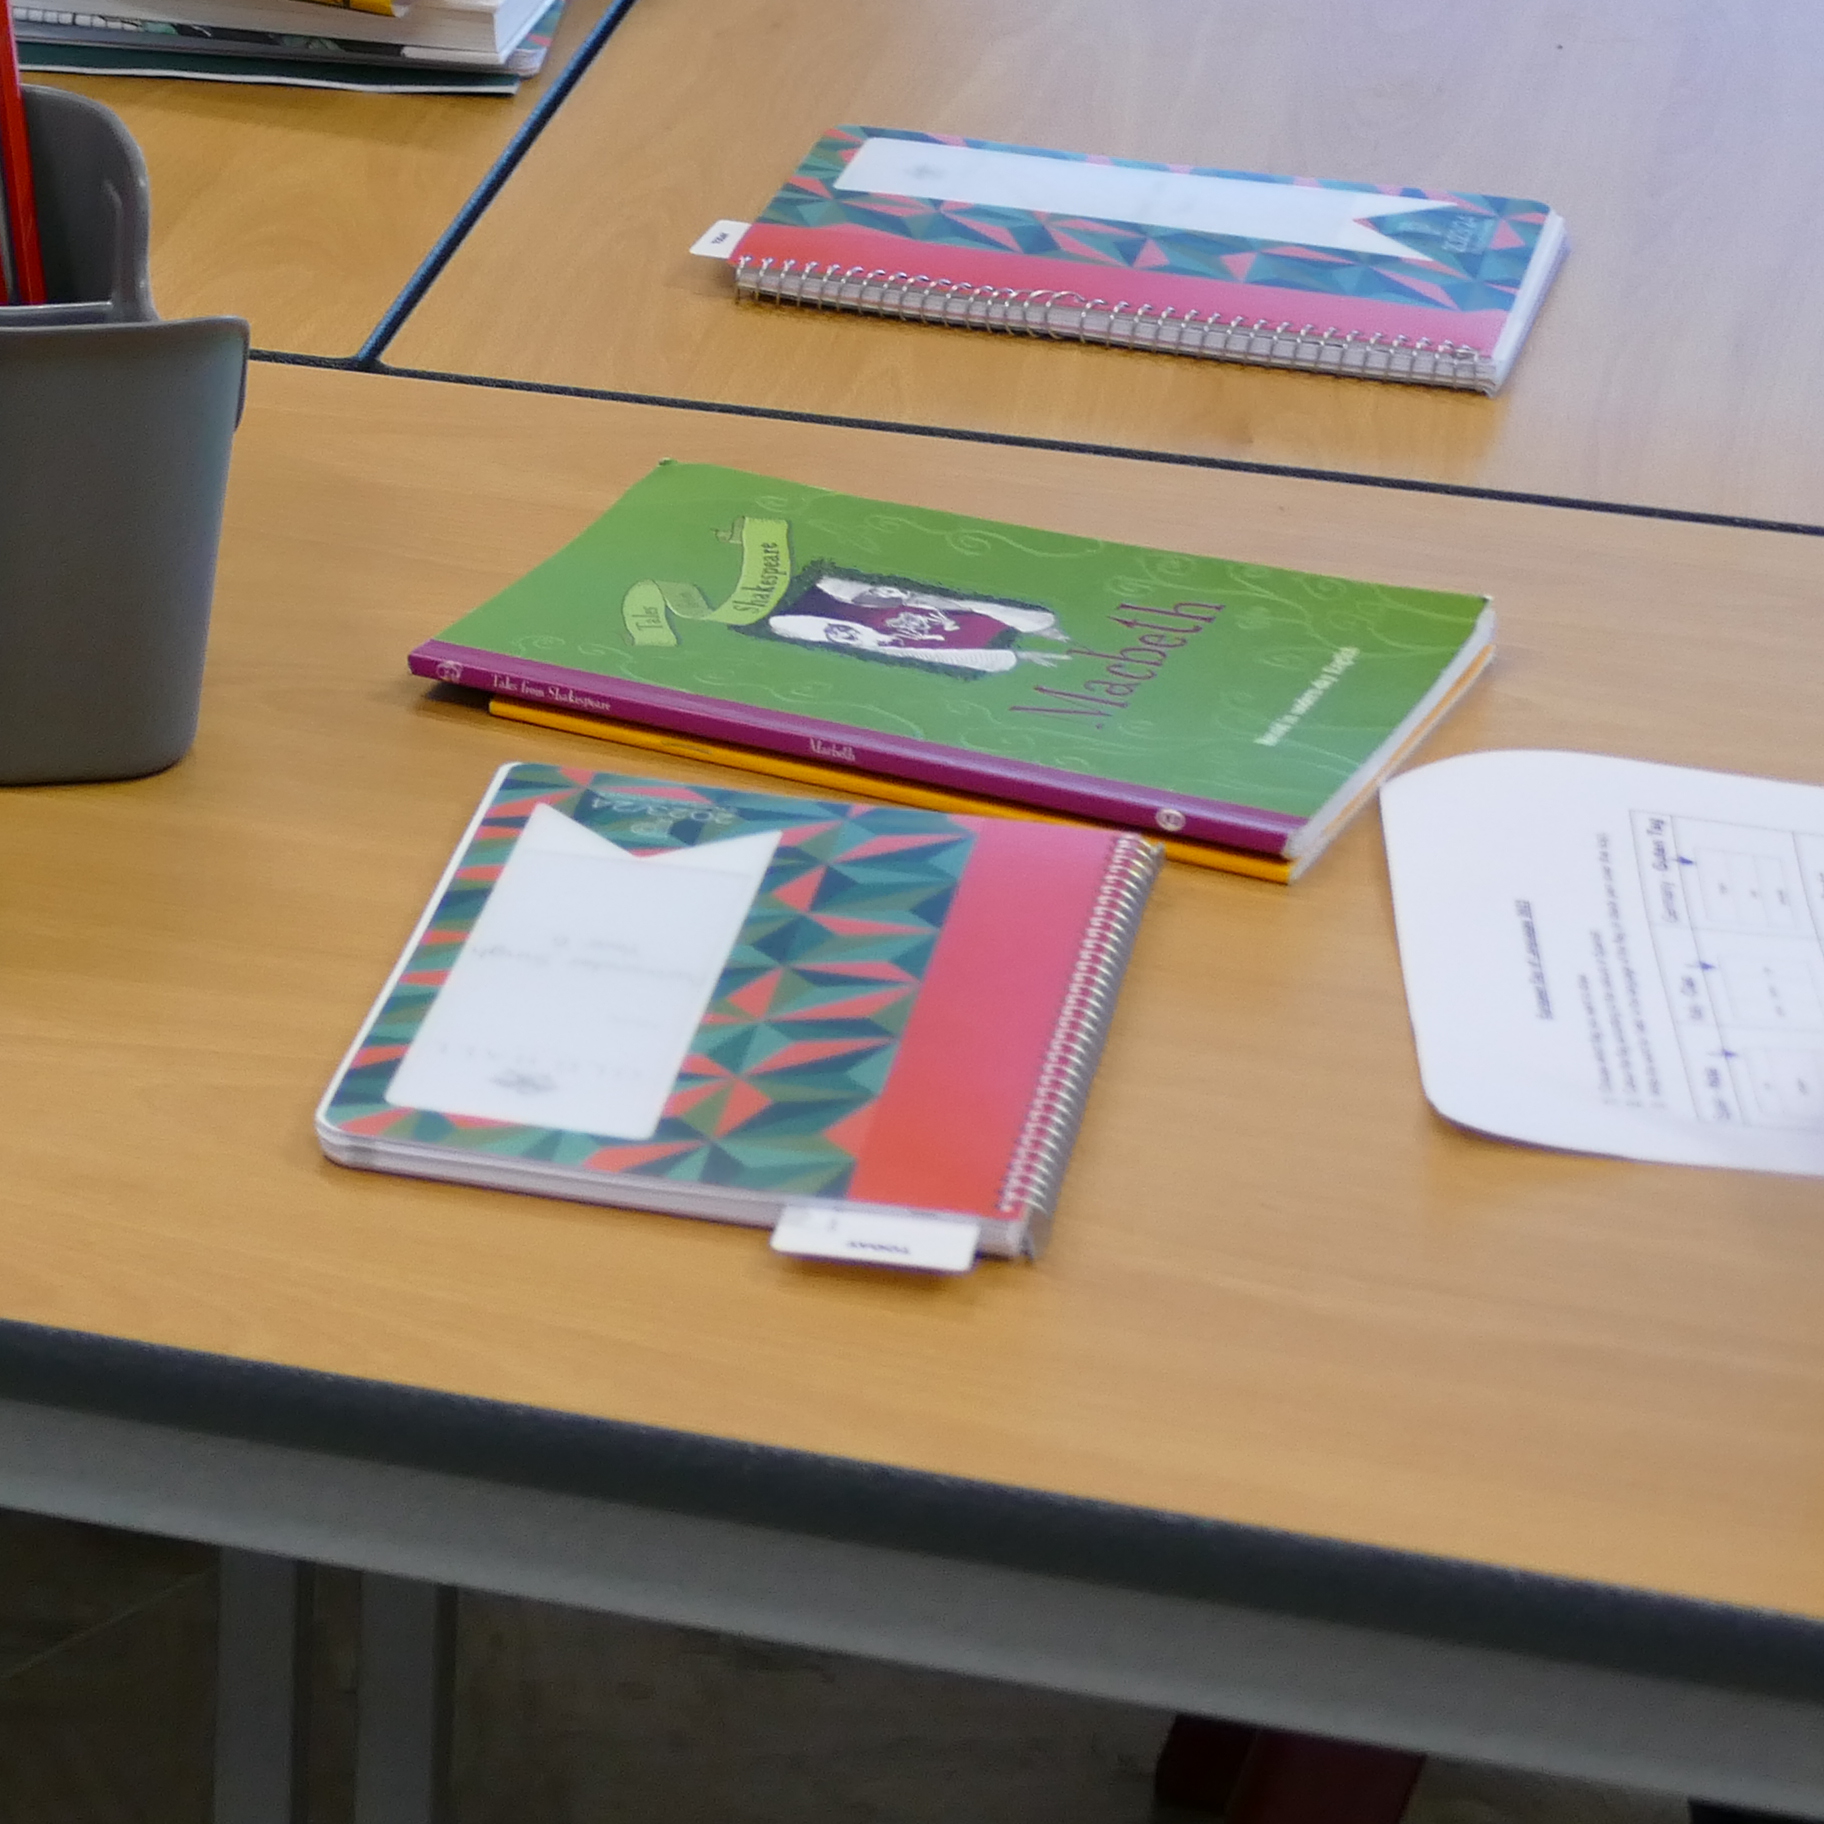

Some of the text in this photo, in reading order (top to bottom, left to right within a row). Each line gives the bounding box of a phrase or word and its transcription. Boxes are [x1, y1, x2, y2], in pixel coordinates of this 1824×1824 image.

[636, 540, 778, 632] Tales Shakespeare
[490, 673, 612, 713] Tales from Shakespeare
[1008, 597, 1227, 730] Macbeth
[808, 736, 857, 763] Macbeth
